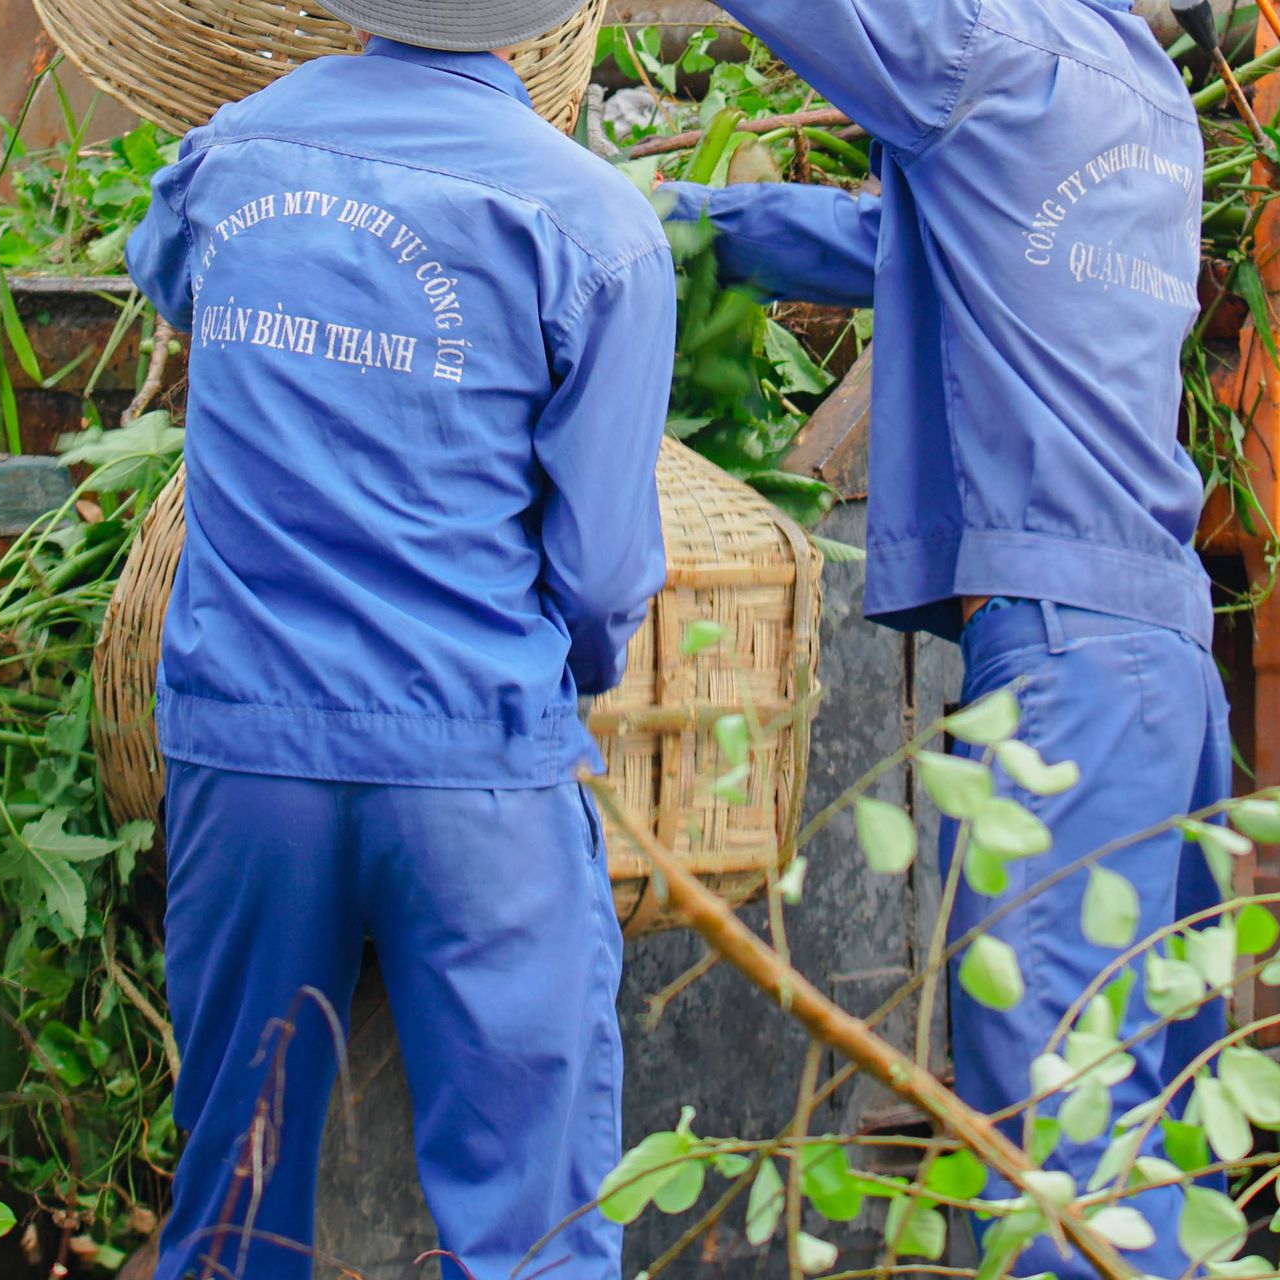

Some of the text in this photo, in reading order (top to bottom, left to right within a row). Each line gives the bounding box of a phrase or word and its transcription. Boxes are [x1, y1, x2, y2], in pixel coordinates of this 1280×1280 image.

[215, 194, 276, 242] TNHH
[283, 191, 338, 217] MTV
[336, 199, 395, 238] DỊCH
[1022, 199, 1067, 266] CÔNG
[1056, 170, 1087, 204] TY
[1085, 144, 1130, 184] TNHH
[390, 223, 429, 264] VỤ
[1069, 240, 1128, 291] QUẬN
[415, 261, 464, 330] CÔNG
[201, 295, 253, 350] QUẬN
[250, 301, 320, 355] BÌNH
[324, 323, 418, 374] THẠNH
[432, 336, 473, 383] ÍCH
